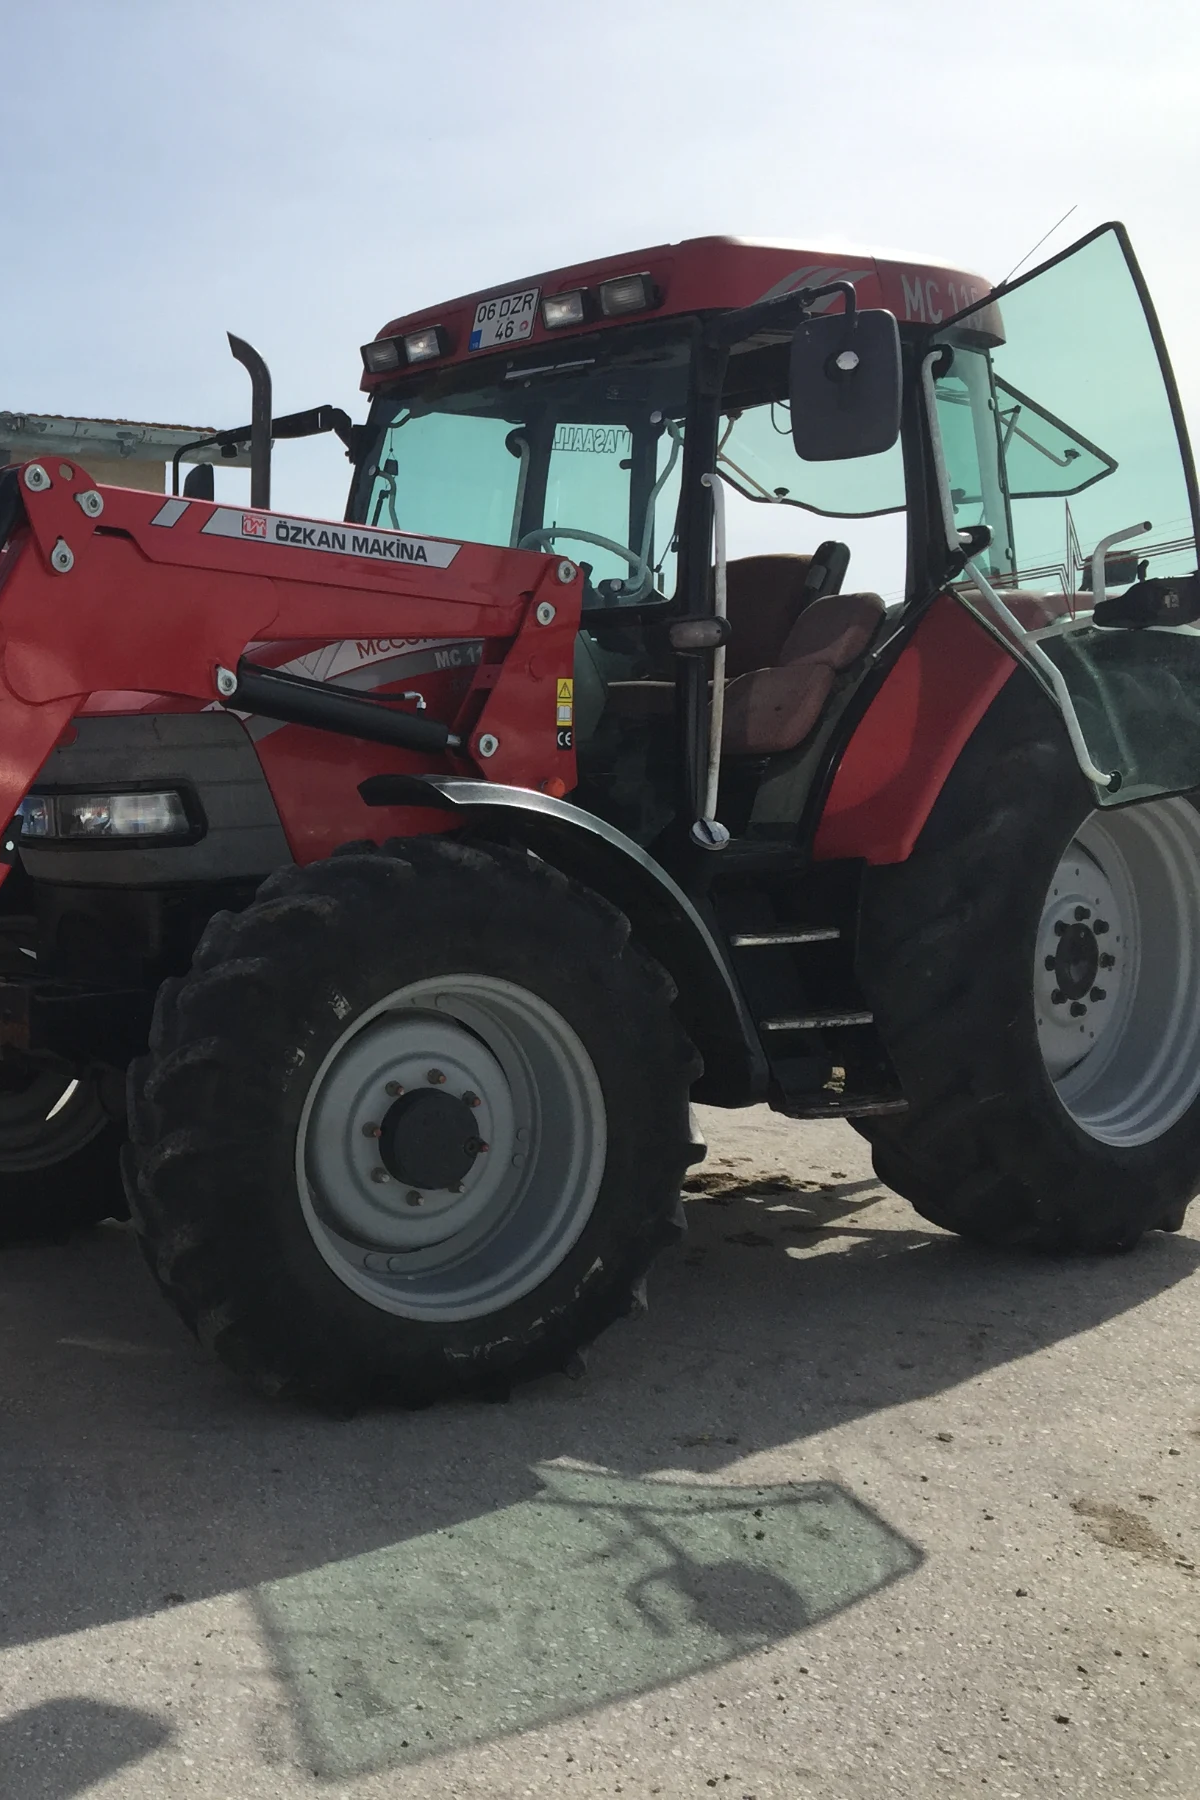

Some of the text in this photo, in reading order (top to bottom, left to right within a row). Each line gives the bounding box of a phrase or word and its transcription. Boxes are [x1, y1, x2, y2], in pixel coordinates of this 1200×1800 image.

[477, 293, 535, 323] 06 DZR
[901, 274, 943, 324] MC
[495, 321, 515, 340] 46
[275, 520, 428, 563] ÖZKAN MAKİNA
[434, 645, 483, 669] MC 11
[557, 731, 572, 746] CE
